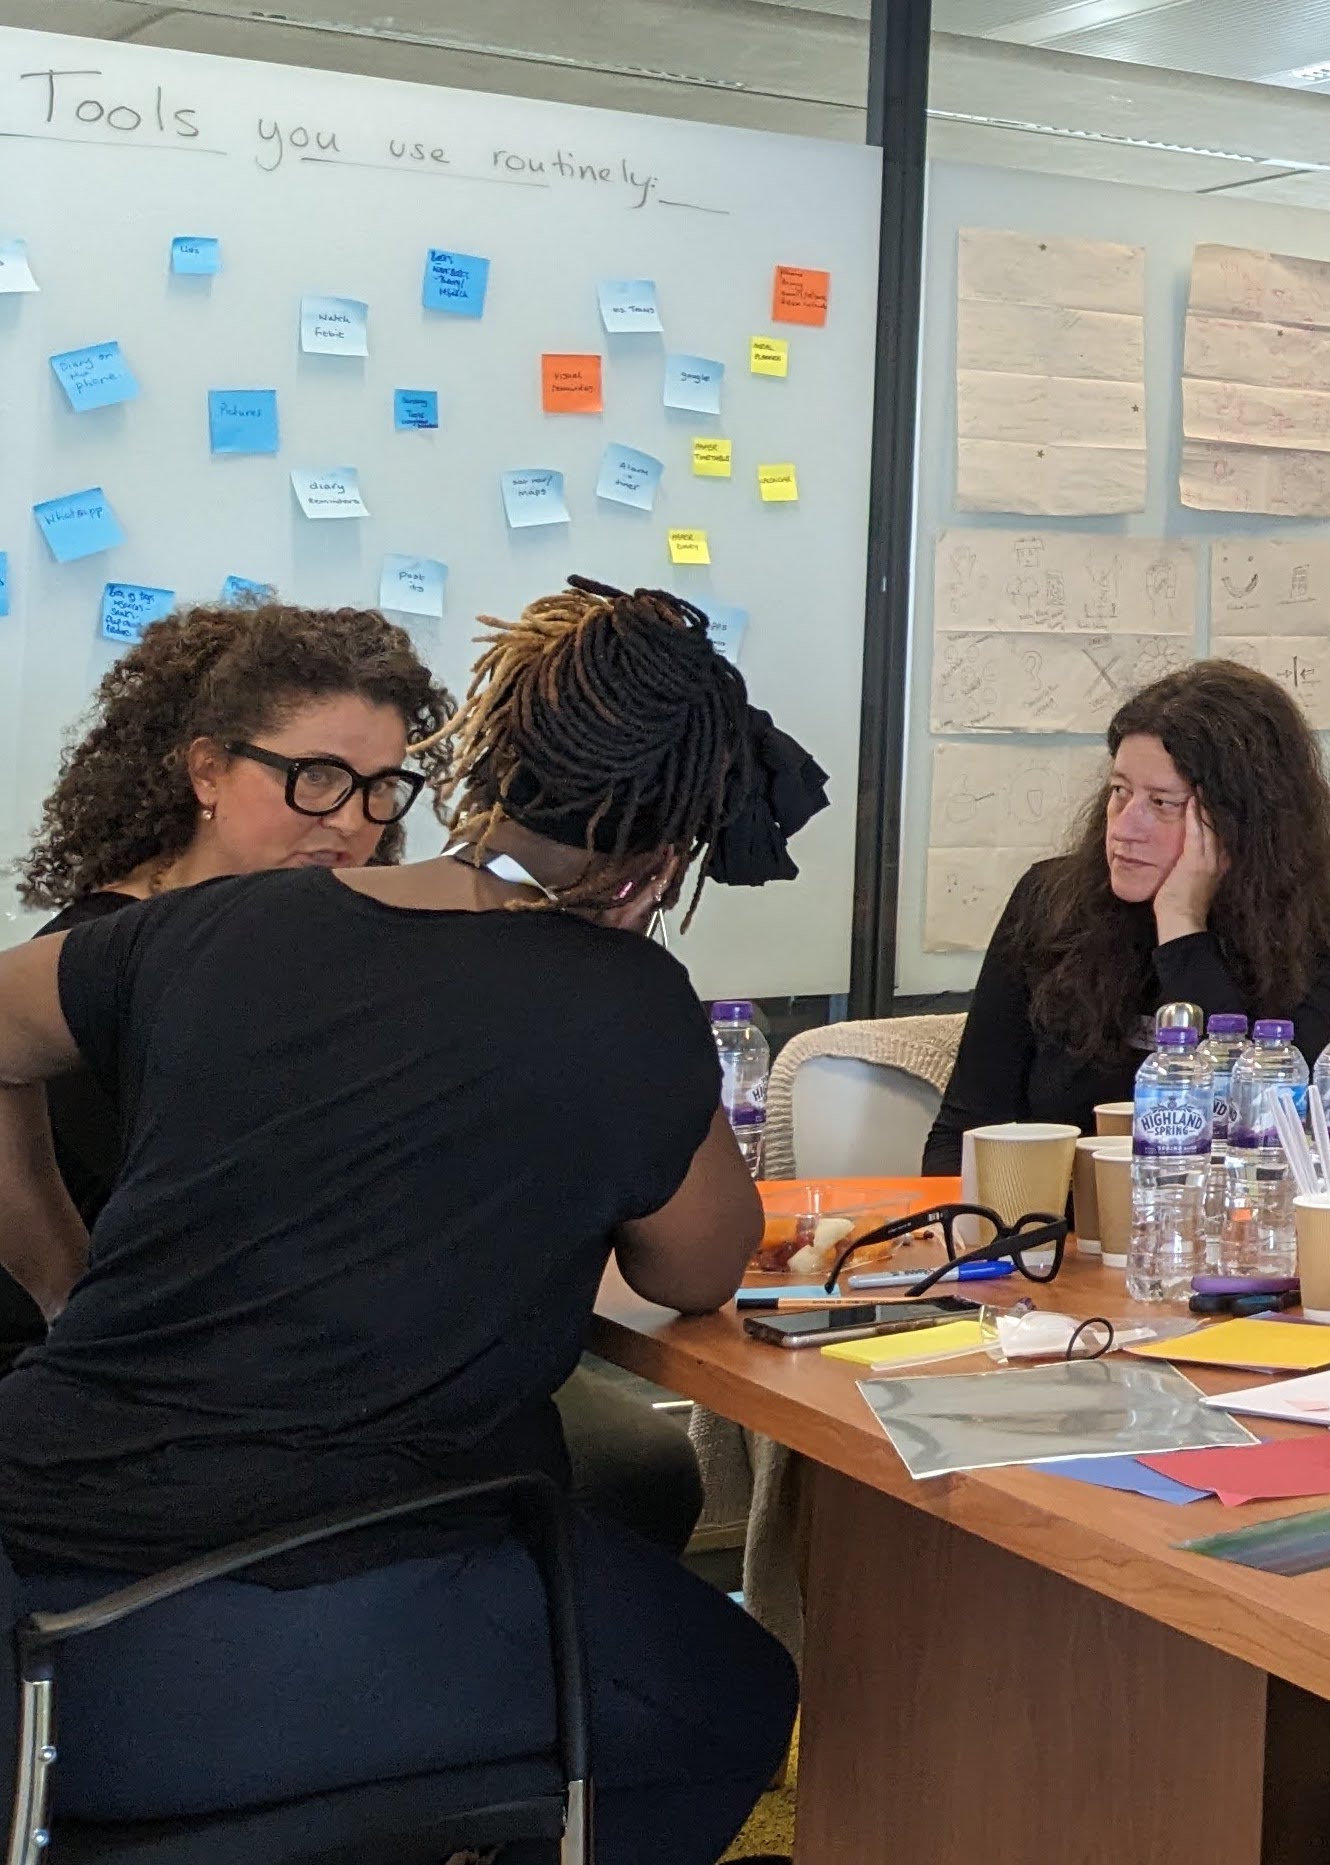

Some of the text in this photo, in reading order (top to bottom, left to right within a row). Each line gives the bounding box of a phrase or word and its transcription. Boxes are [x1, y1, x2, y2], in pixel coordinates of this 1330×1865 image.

[21, 69, 199, 137] Tools
[255, 118, 340, 171] you
[389, 139, 449, 163] use
[309, 481, 346, 494] diary
[1140, 1111, 1203, 1131] HIGHLAND
[1154, 1126, 1189, 1136] SPRING
